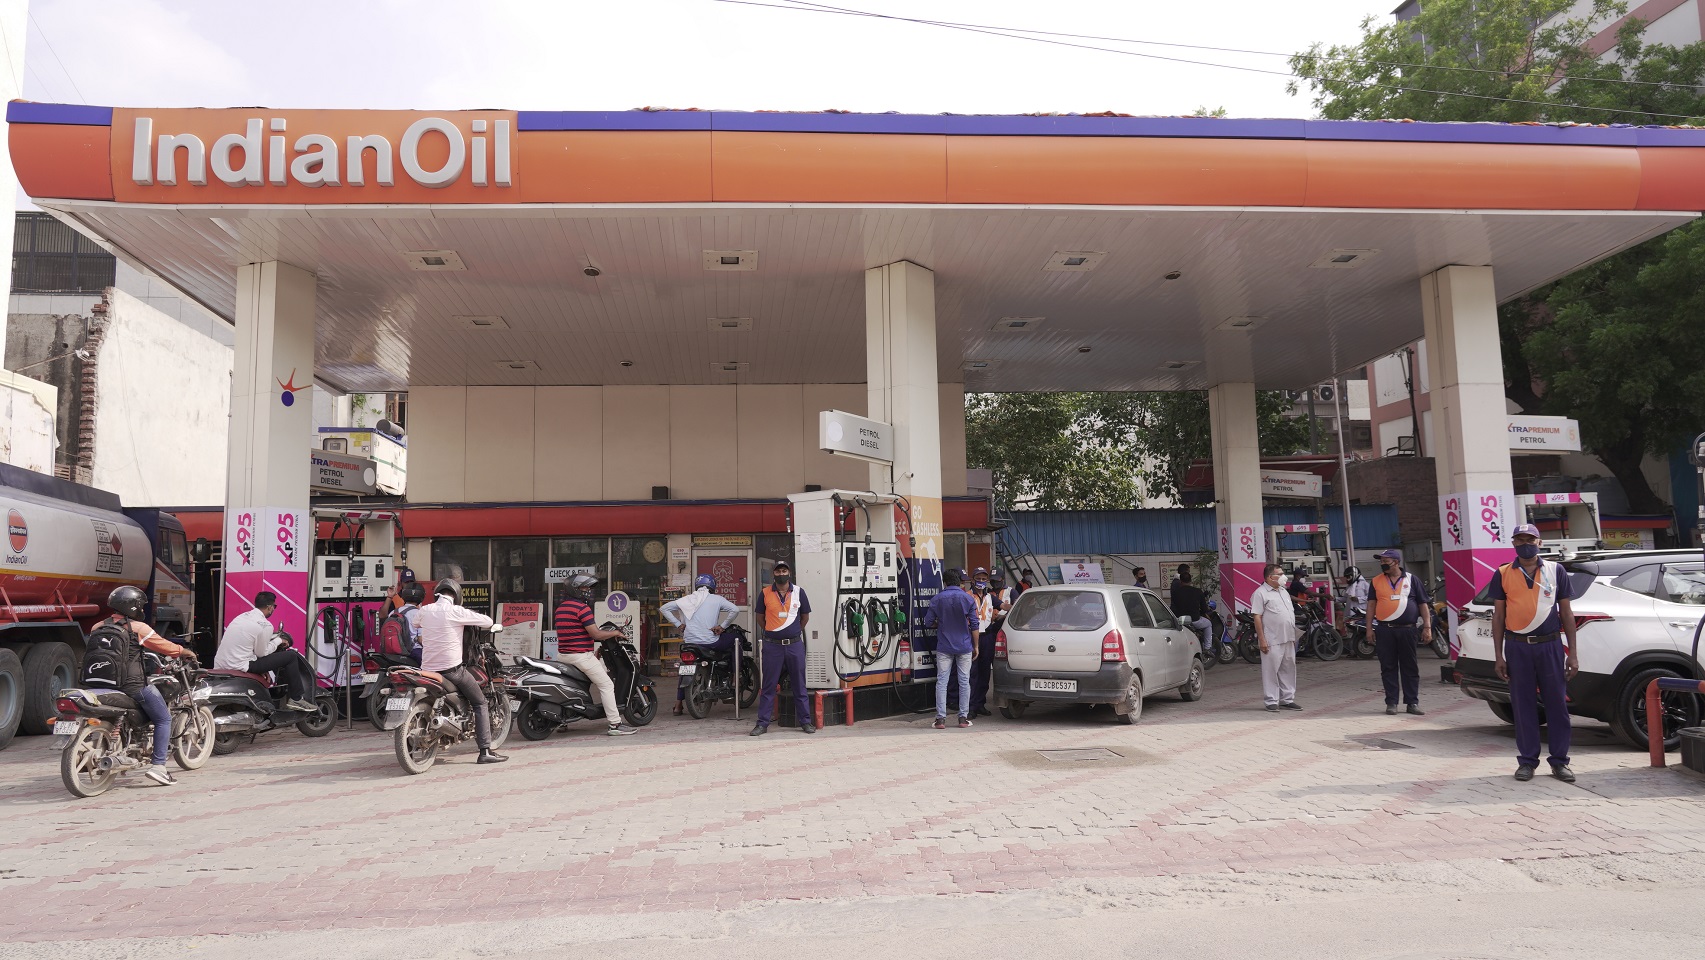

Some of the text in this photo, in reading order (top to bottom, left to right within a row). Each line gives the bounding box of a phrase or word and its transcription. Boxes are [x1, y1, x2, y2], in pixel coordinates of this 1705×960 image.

[132, 117, 512, 188] IndianOil
[859, 428, 880, 440] PETROL
[1520, 436, 1546, 444] PETROL
[860, 439, 879, 450] DIESEL
[319, 467, 345, 478] PETROL
[320, 476, 343, 487] DIESEL
[912, 505, 923, 519] GO
[1446, 498, 1461, 546] XP95
[1480, 495, 1501, 543] XP95
[236, 513, 252, 566] XP95
[276, 513, 295, 566] XP95
[1240, 526, 1254, 559] XP95
[549, 569, 570, 578] CHECK
[470, 588, 476, 596] &
[477, 588, 489, 596] FILL
